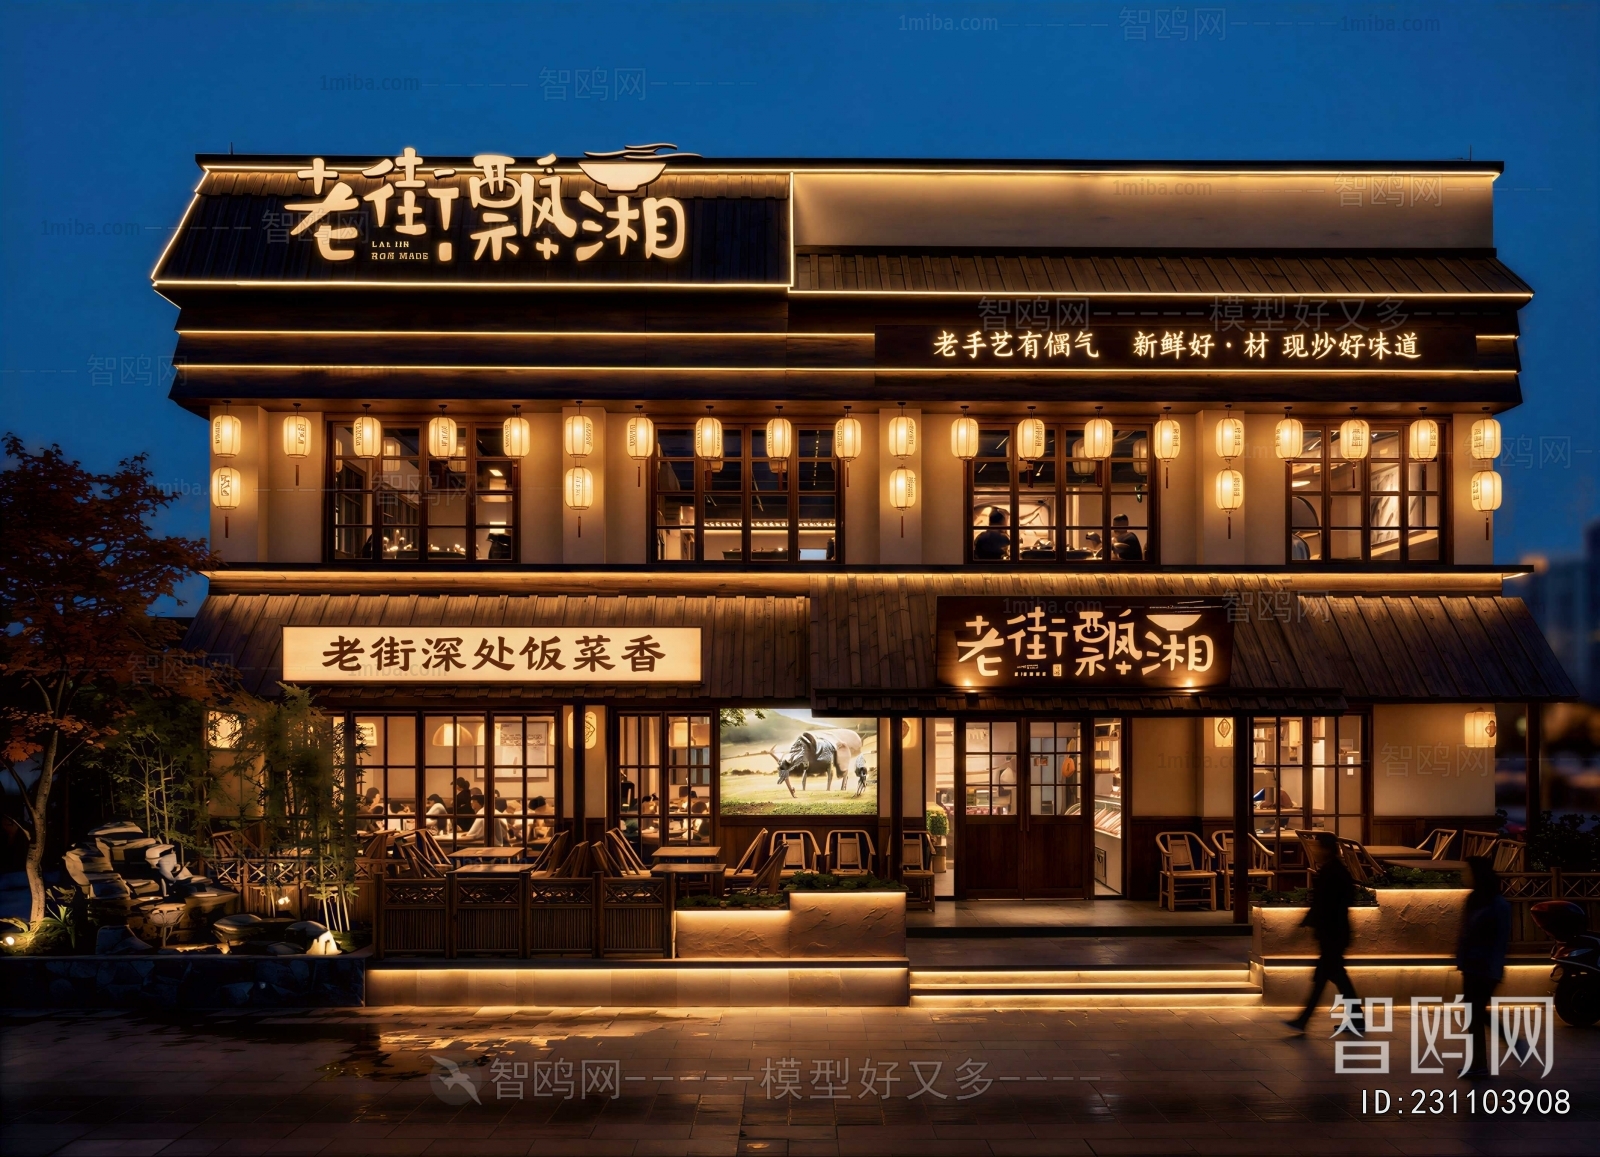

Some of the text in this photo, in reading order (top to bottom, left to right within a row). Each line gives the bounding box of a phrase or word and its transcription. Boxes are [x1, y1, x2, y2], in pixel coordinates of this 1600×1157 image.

[321, 635, 667, 673] 老街深处饭菜香
